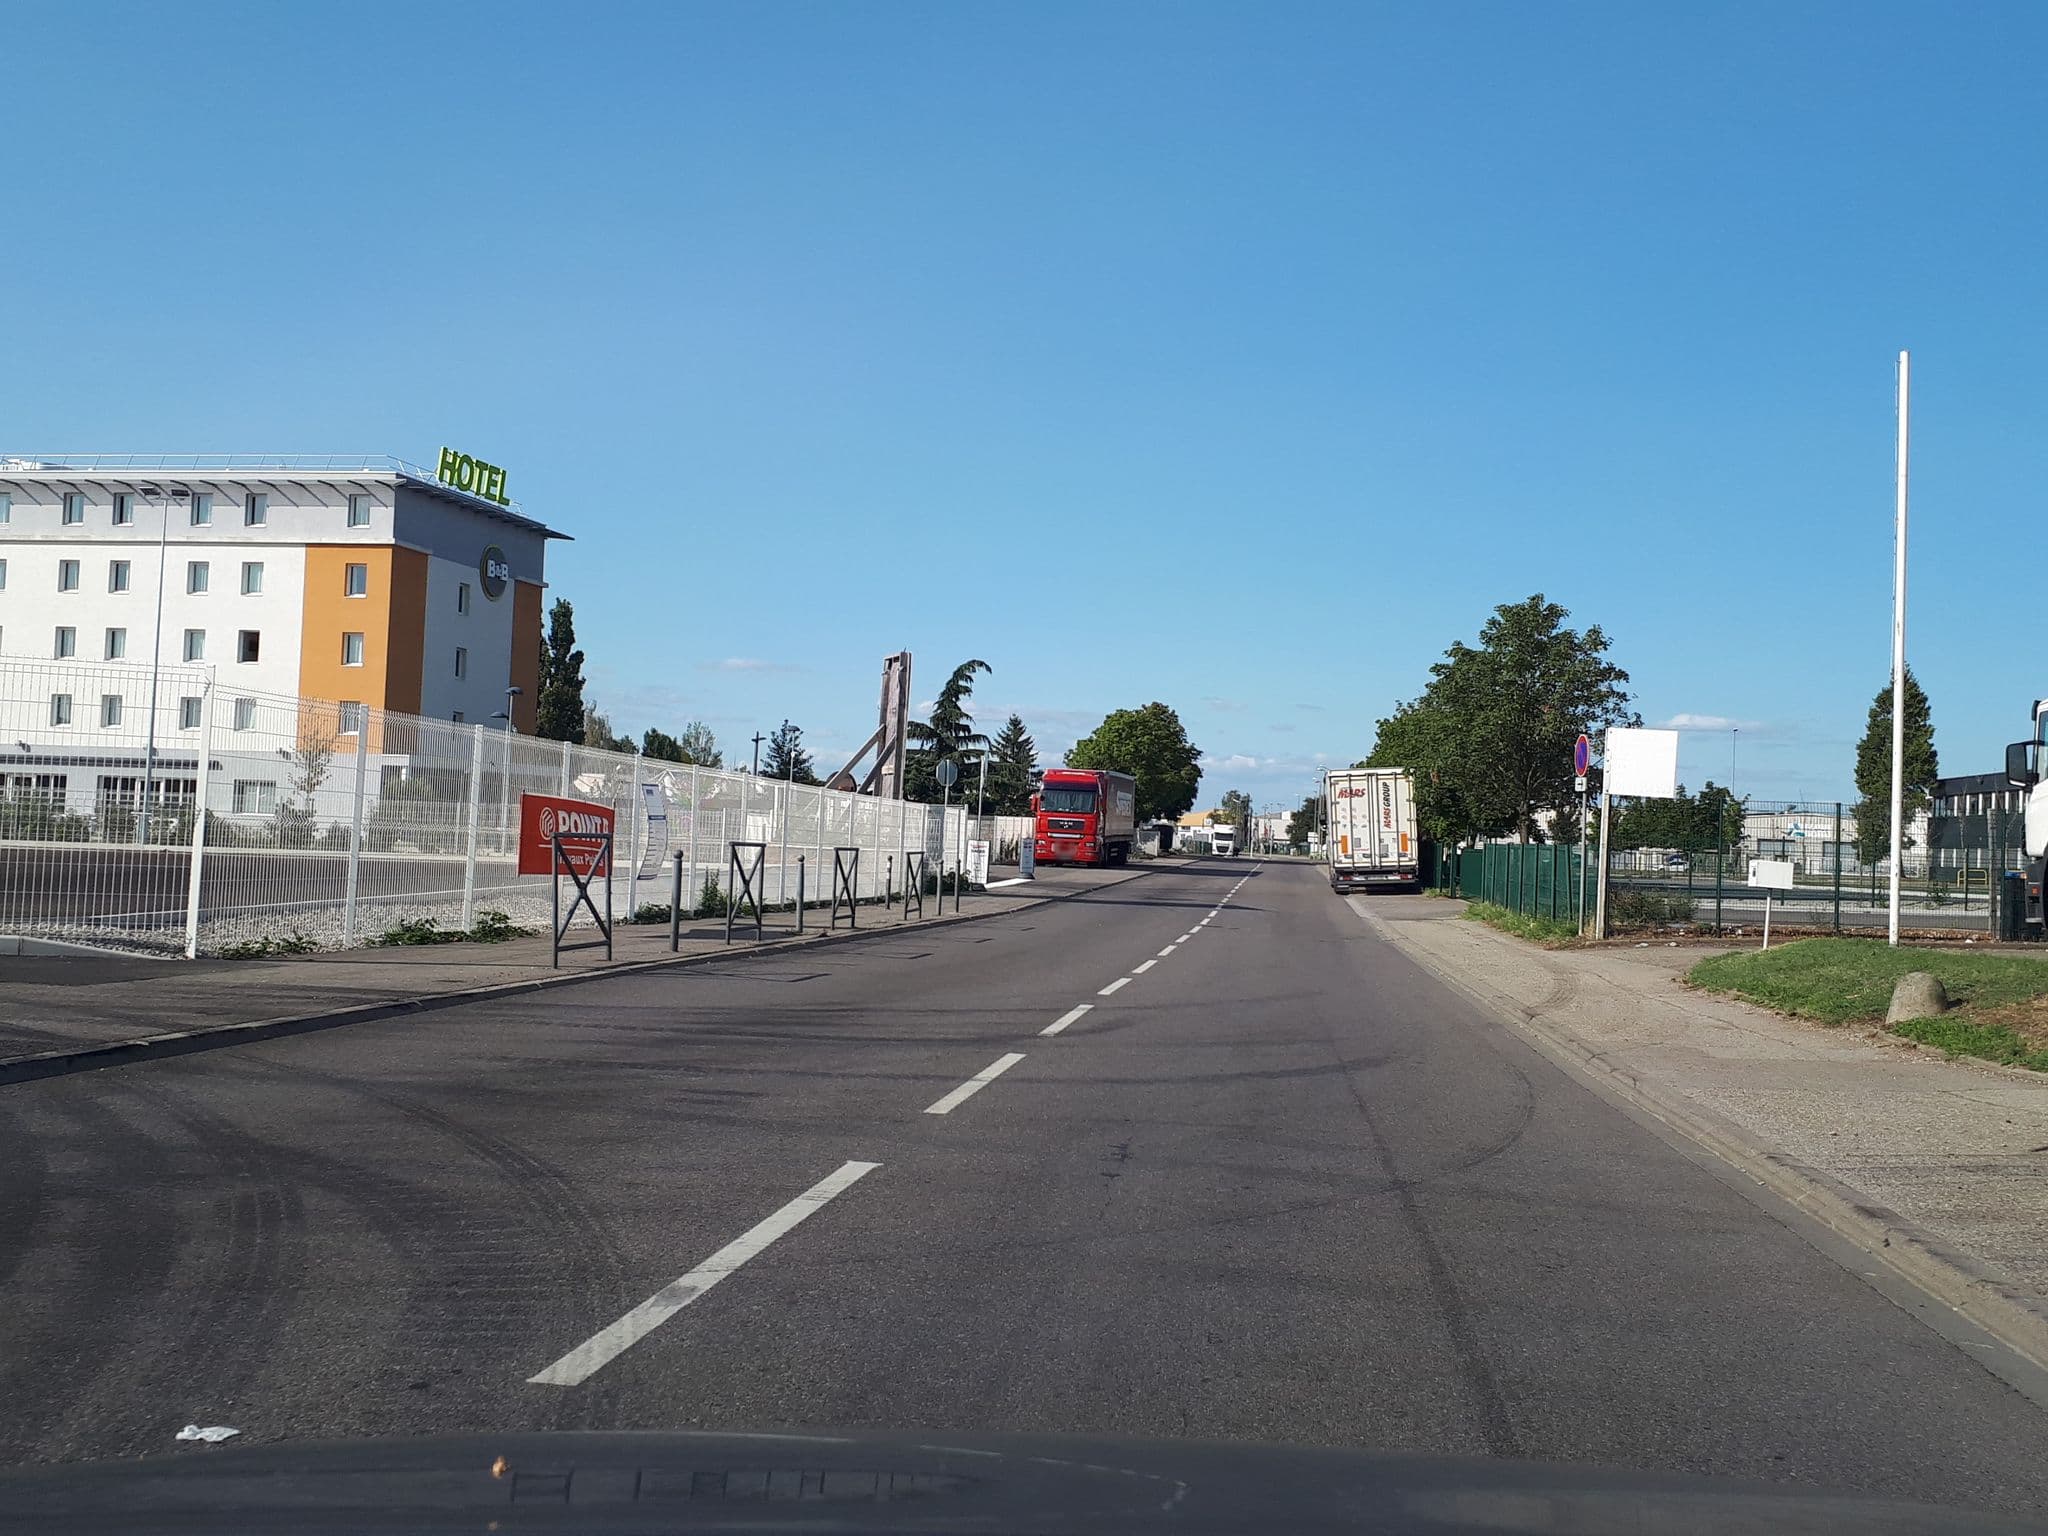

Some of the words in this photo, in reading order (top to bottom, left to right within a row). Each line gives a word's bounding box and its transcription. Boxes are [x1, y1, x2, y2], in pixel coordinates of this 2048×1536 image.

[437, 446, 511, 506] HOTEL
[487, 559, 509, 581] B&B
[1382, 781, 1391, 807] GROUP
[557, 810, 601, 842] POINT
